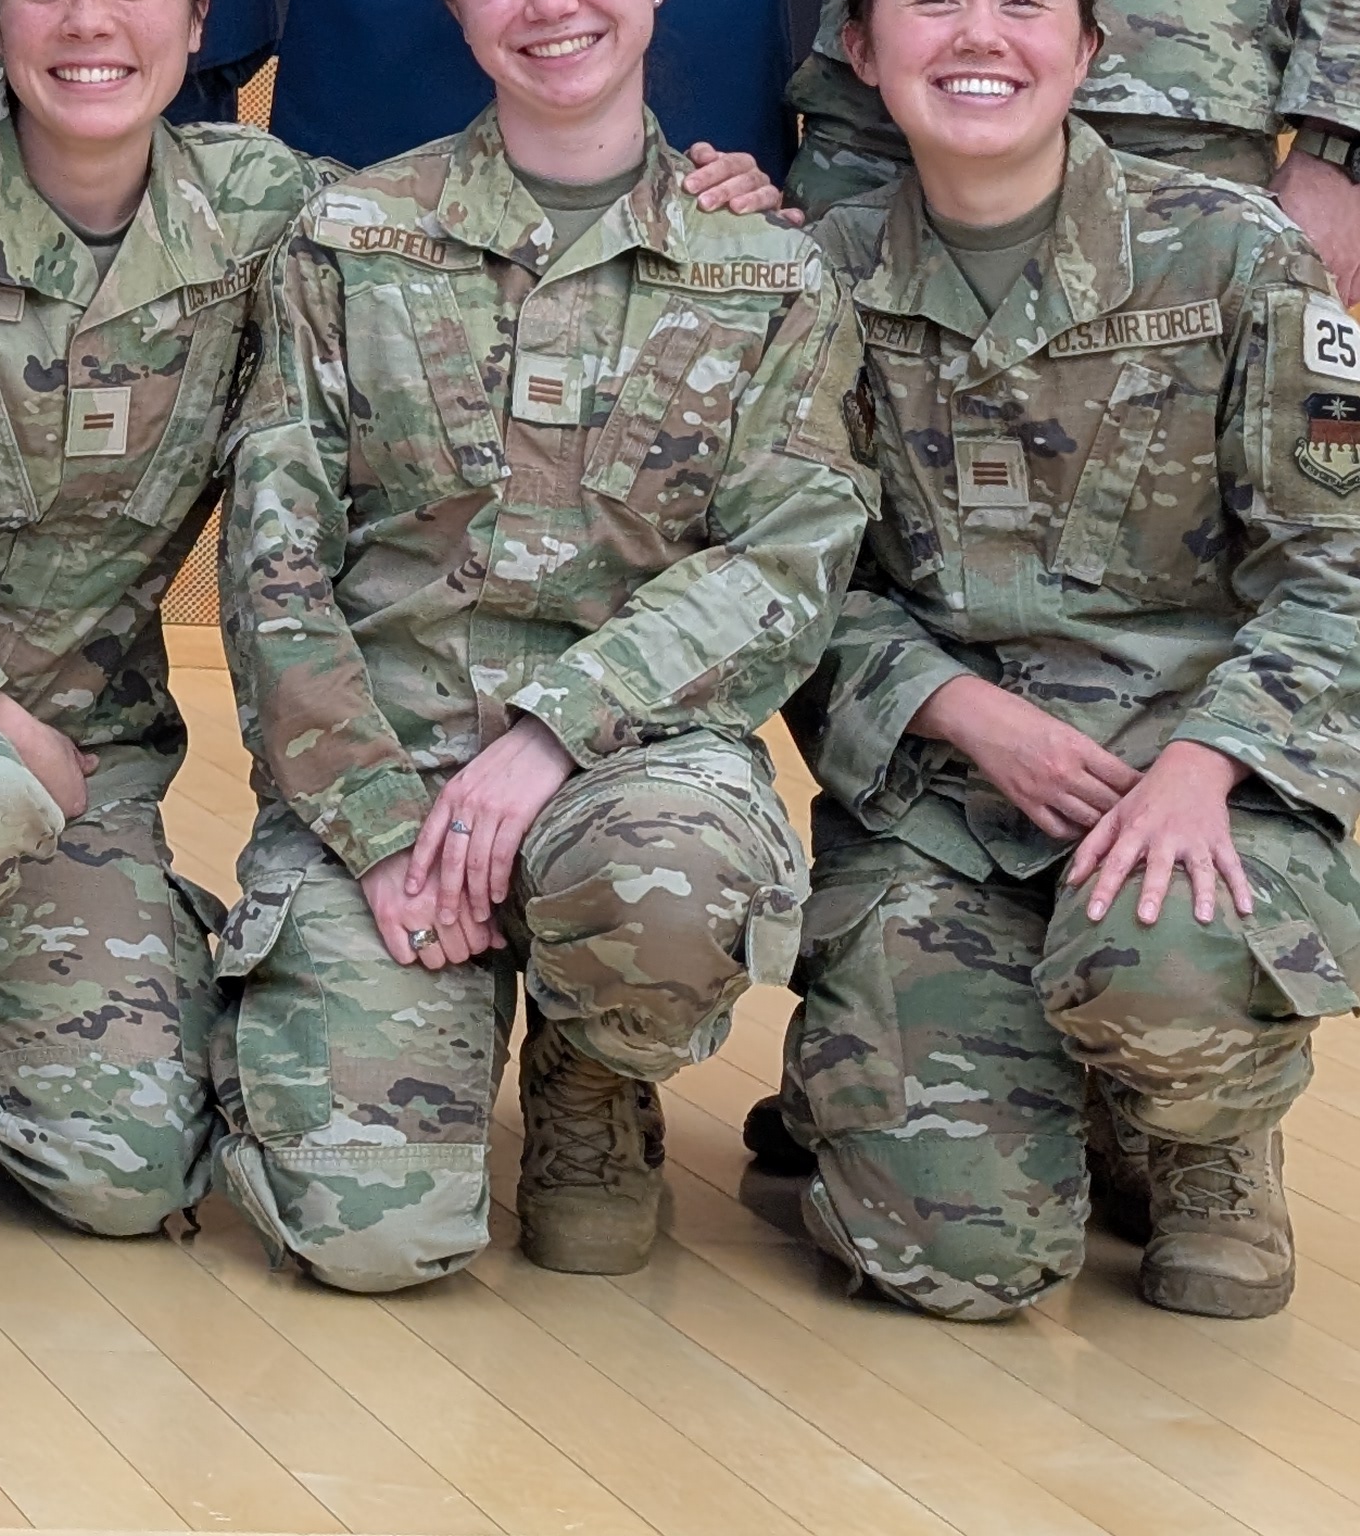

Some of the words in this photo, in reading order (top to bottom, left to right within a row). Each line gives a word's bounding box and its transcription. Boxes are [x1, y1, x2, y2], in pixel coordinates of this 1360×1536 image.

[349, 226, 447, 265] SCOFIELD
[690, 263, 725, 287] AIR
[731, 262, 798, 288] FORCE
[1056, 320, 1099, 353] U.S.
[1105, 318, 1139, 346] AIR
[1146, 304, 1213, 340] FORCE
[1316, 319, 1356, 368] 25
